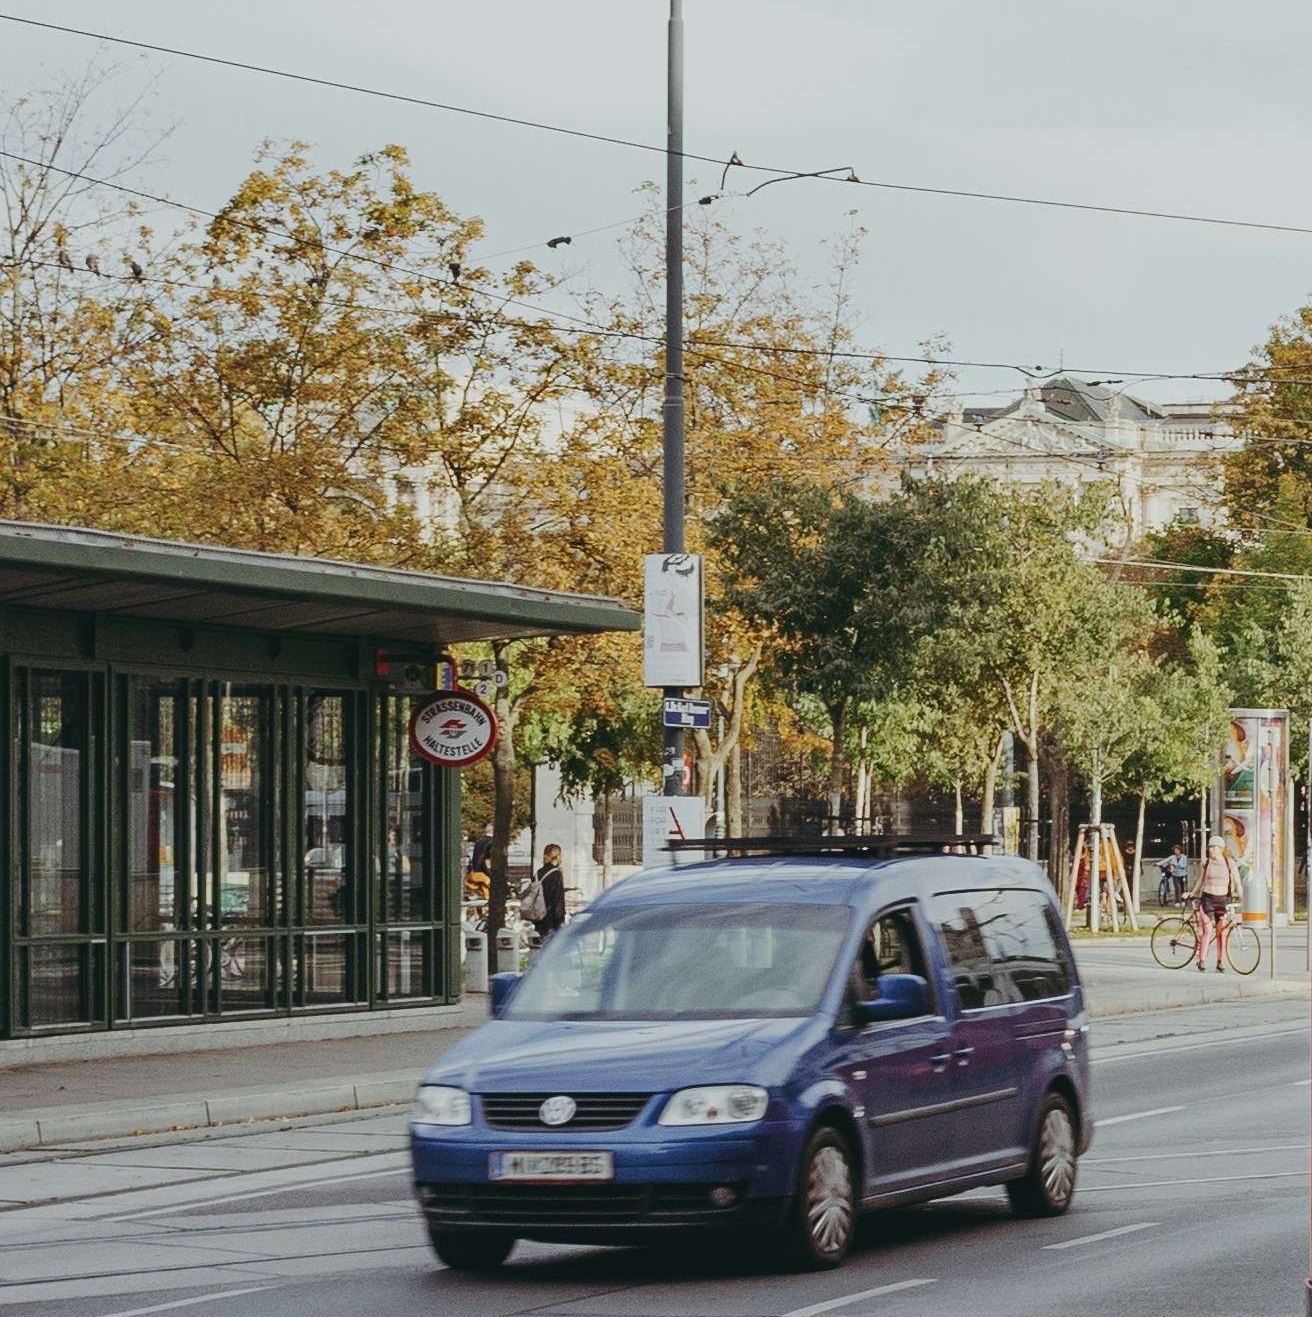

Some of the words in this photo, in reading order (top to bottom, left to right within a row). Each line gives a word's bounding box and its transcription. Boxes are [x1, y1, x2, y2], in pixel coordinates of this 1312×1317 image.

[495, 673, 503, 684] D
[479, 684, 487, 694] 2
[421, 701, 487, 727] STRASSENBAHN
[423, 735, 483, 757] HALTESTELLE
